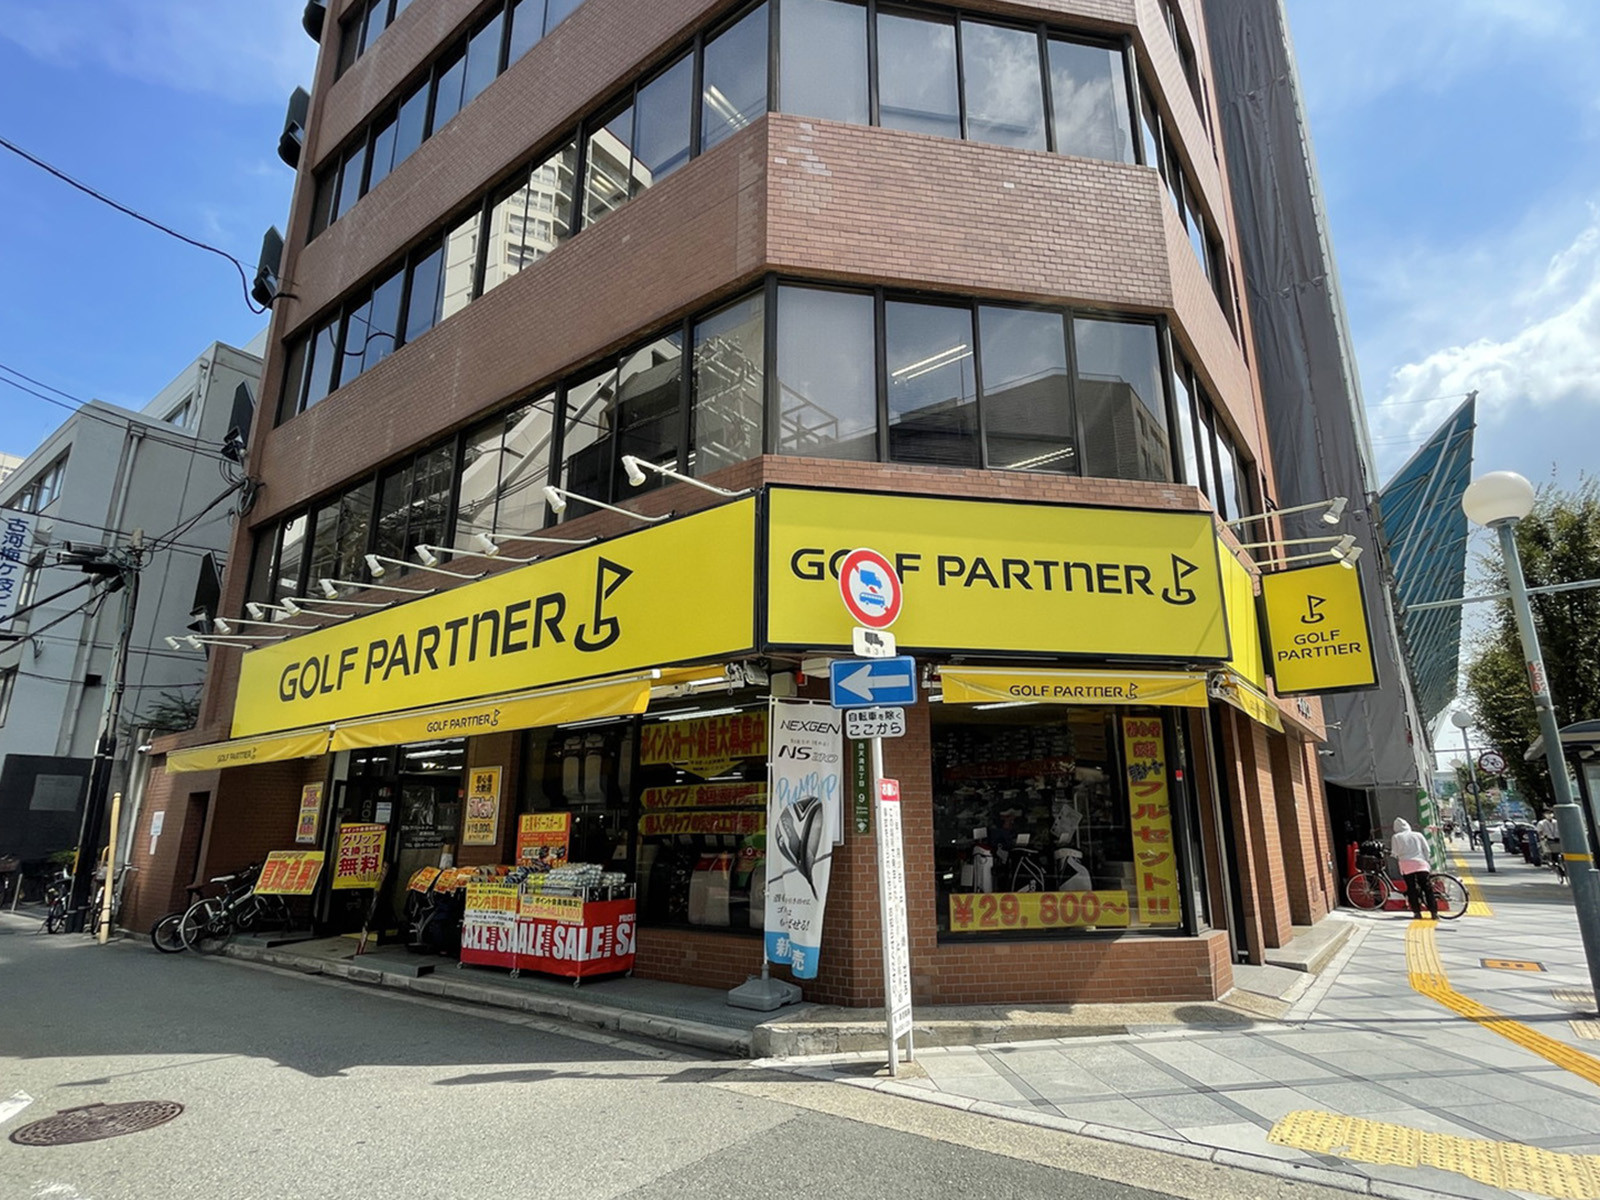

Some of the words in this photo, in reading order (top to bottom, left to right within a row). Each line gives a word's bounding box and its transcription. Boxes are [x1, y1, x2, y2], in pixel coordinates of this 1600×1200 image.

[790, 548, 921, 585] GF
[937, 555, 1155, 595] PARTNER
[1294, 629, 1340, 645] GOLF
[279, 646, 358, 702] GOLF
[364, 592, 566, 684] PARTNER
[1278, 642, 1362, 661] PARTNER
[1009, 685, 1050, 697] GOLF
[1054, 685, 1123, 698] PARTNER
[426, 719, 448, 733] GOLF
[449, 714, 490, 730] PARTNER
[848, 711, 902, 721] 自転車を除く
[780, 720, 840, 735] NEXGEN
[849, 722, 902, 736] ここから
[858, 793, 866, 803] 9
[342, 833, 383, 845] グリップ
[340, 844, 382, 857] 交換工賃
[338, 855, 380, 877] 無料
[776, 936, 806, 970] 新売
